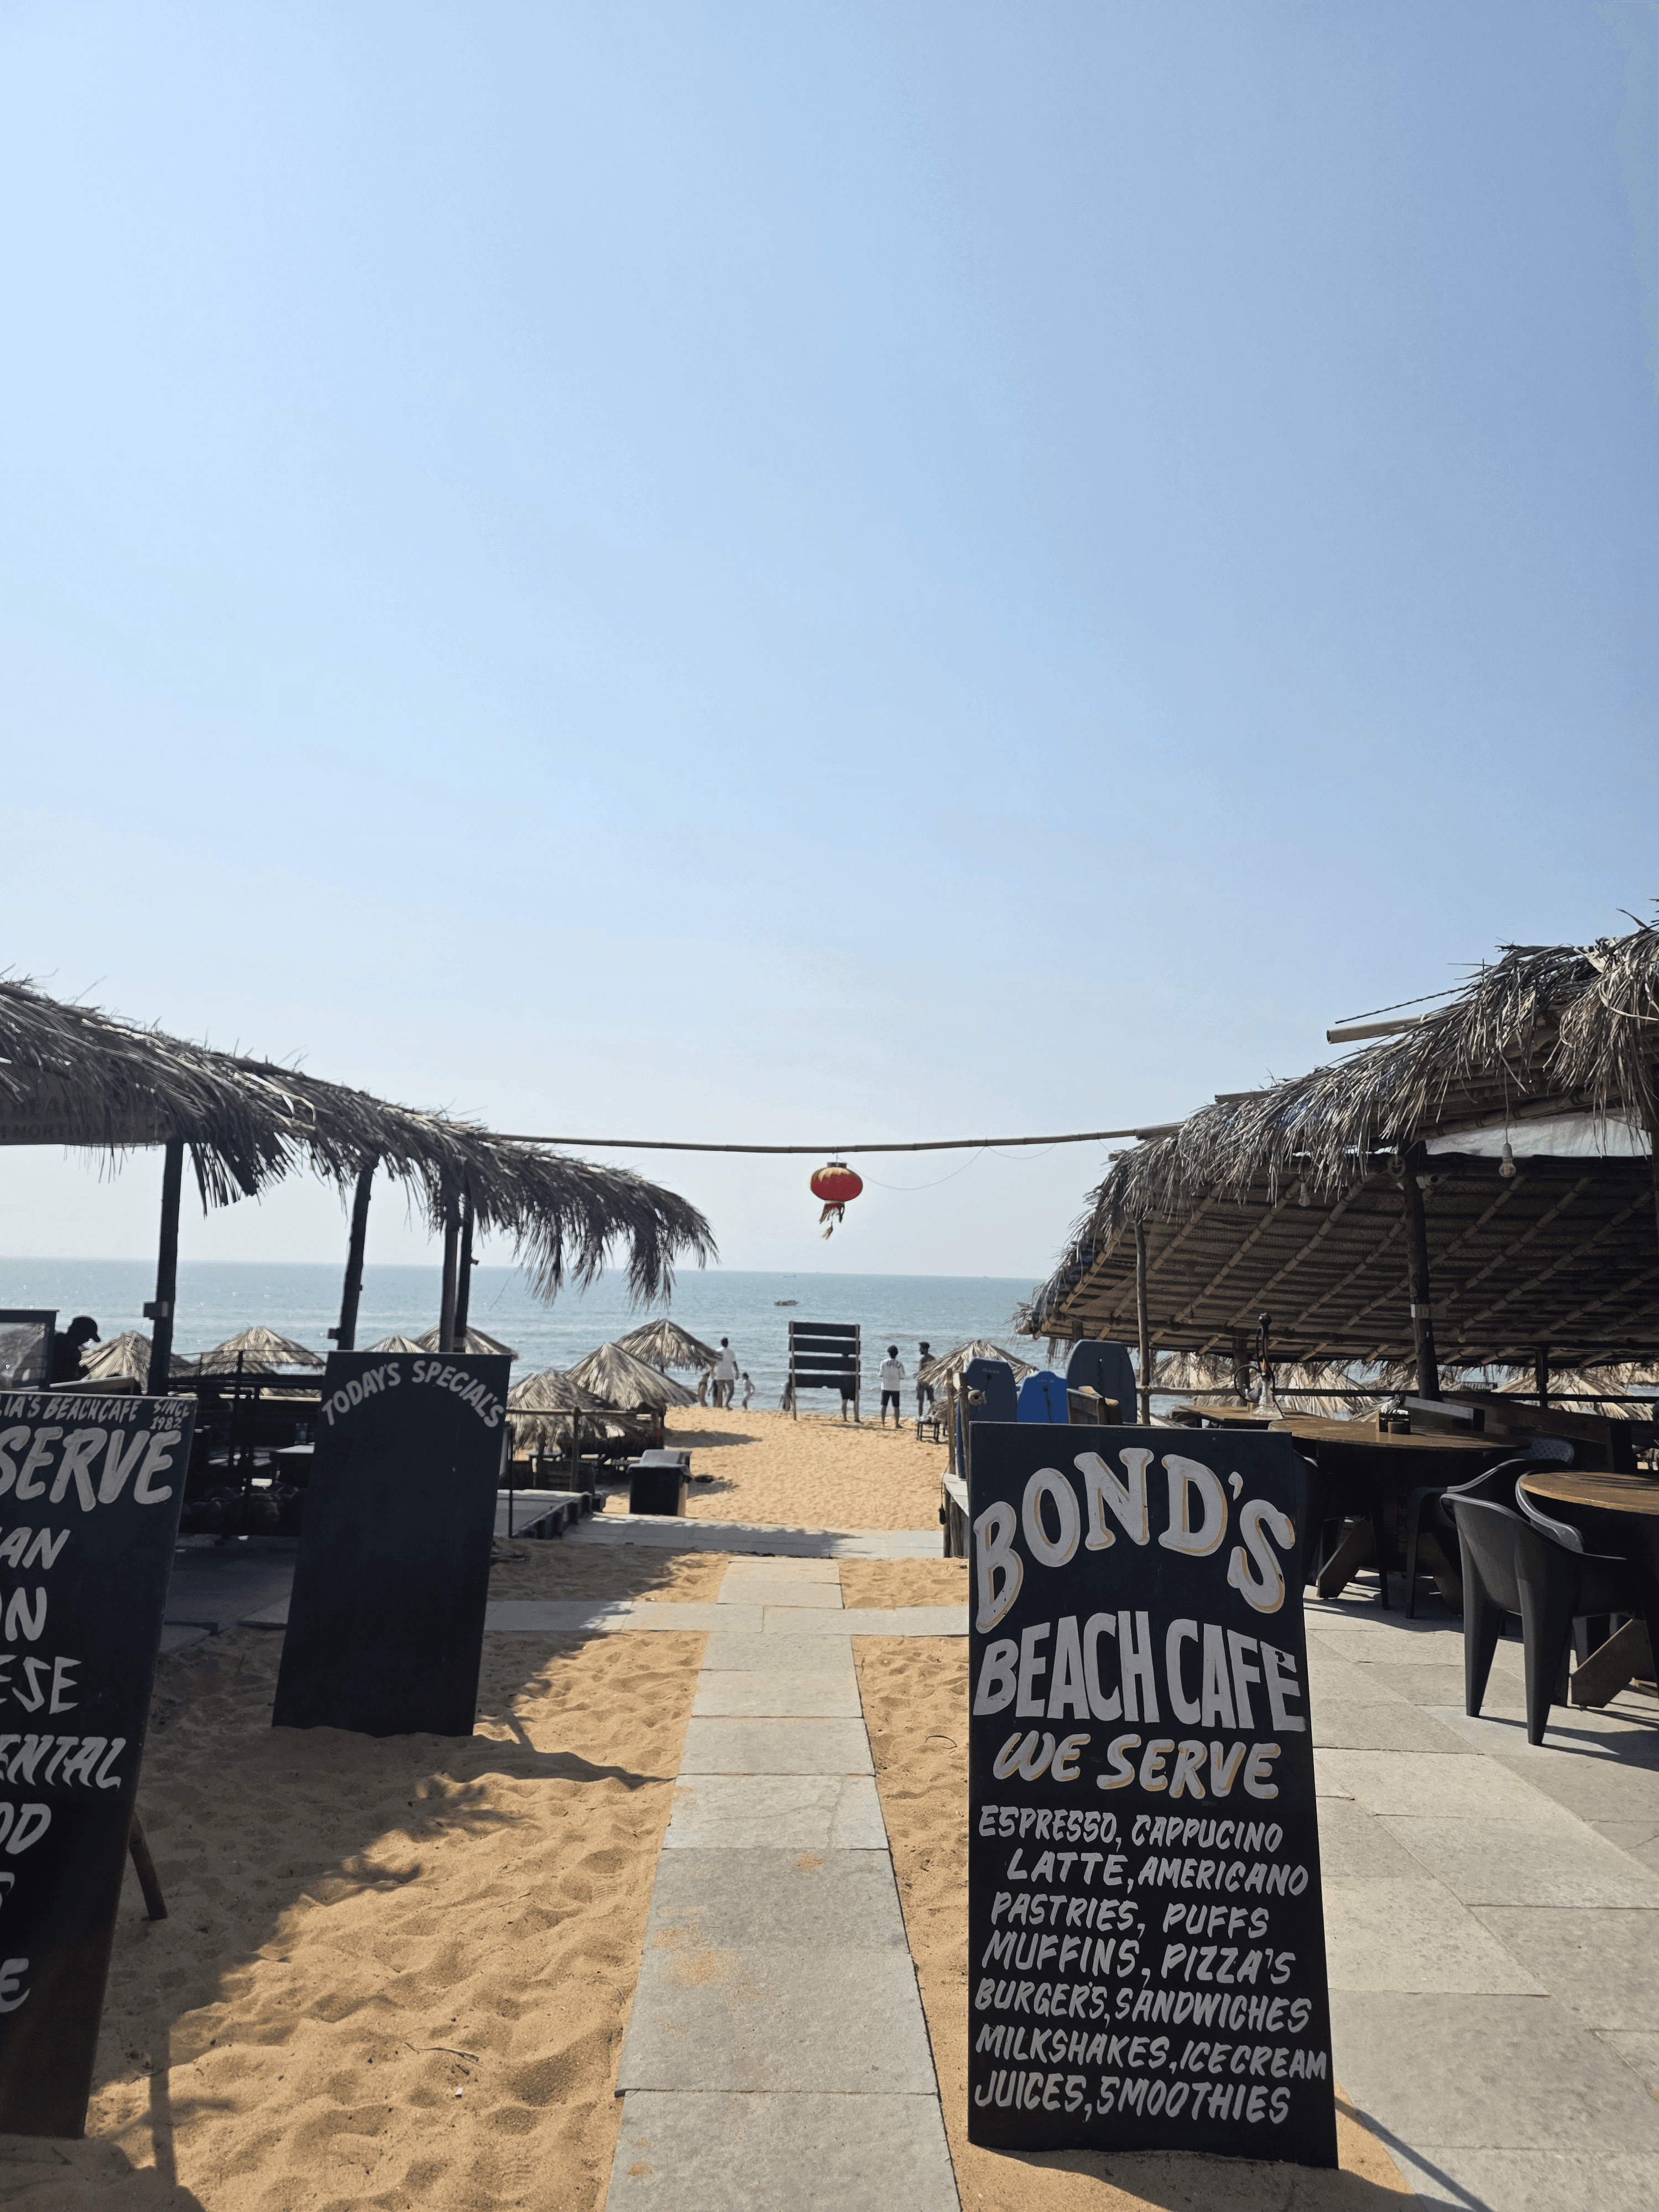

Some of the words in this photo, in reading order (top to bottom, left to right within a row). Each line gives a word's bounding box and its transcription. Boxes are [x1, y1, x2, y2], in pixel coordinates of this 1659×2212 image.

[0, 1394, 41, 1418] IA'S
[153, 1399, 191, 1417] SINCE
[321, 1362, 401, 1426] TODAY'S
[411, 1360, 505, 1428] SPECIAL'S
[150, 1417, 182, 1431] 1982
[0, 1526, 71, 1569] AN
[973, 1447, 1295, 1634] BOND'S
[973, 1610, 1160, 1723] BEACH
[1165, 1619, 1307, 1731] CAFE
[993, 1730, 1091, 1782] WE
[1097, 1734, 1281, 1799] SERVE
[978, 1805, 1122, 1851] ESPRESSO,
[1131, 1815, 1283, 1853] CAPPUCINO
[991, 1891, 1146, 1938] PASTRIES,
[1162, 1903, 1269, 1939] PUFFS
[982, 1929, 1151, 1987] MUFFINS,
[1161, 1943, 1296, 1984] PIZZA'S
